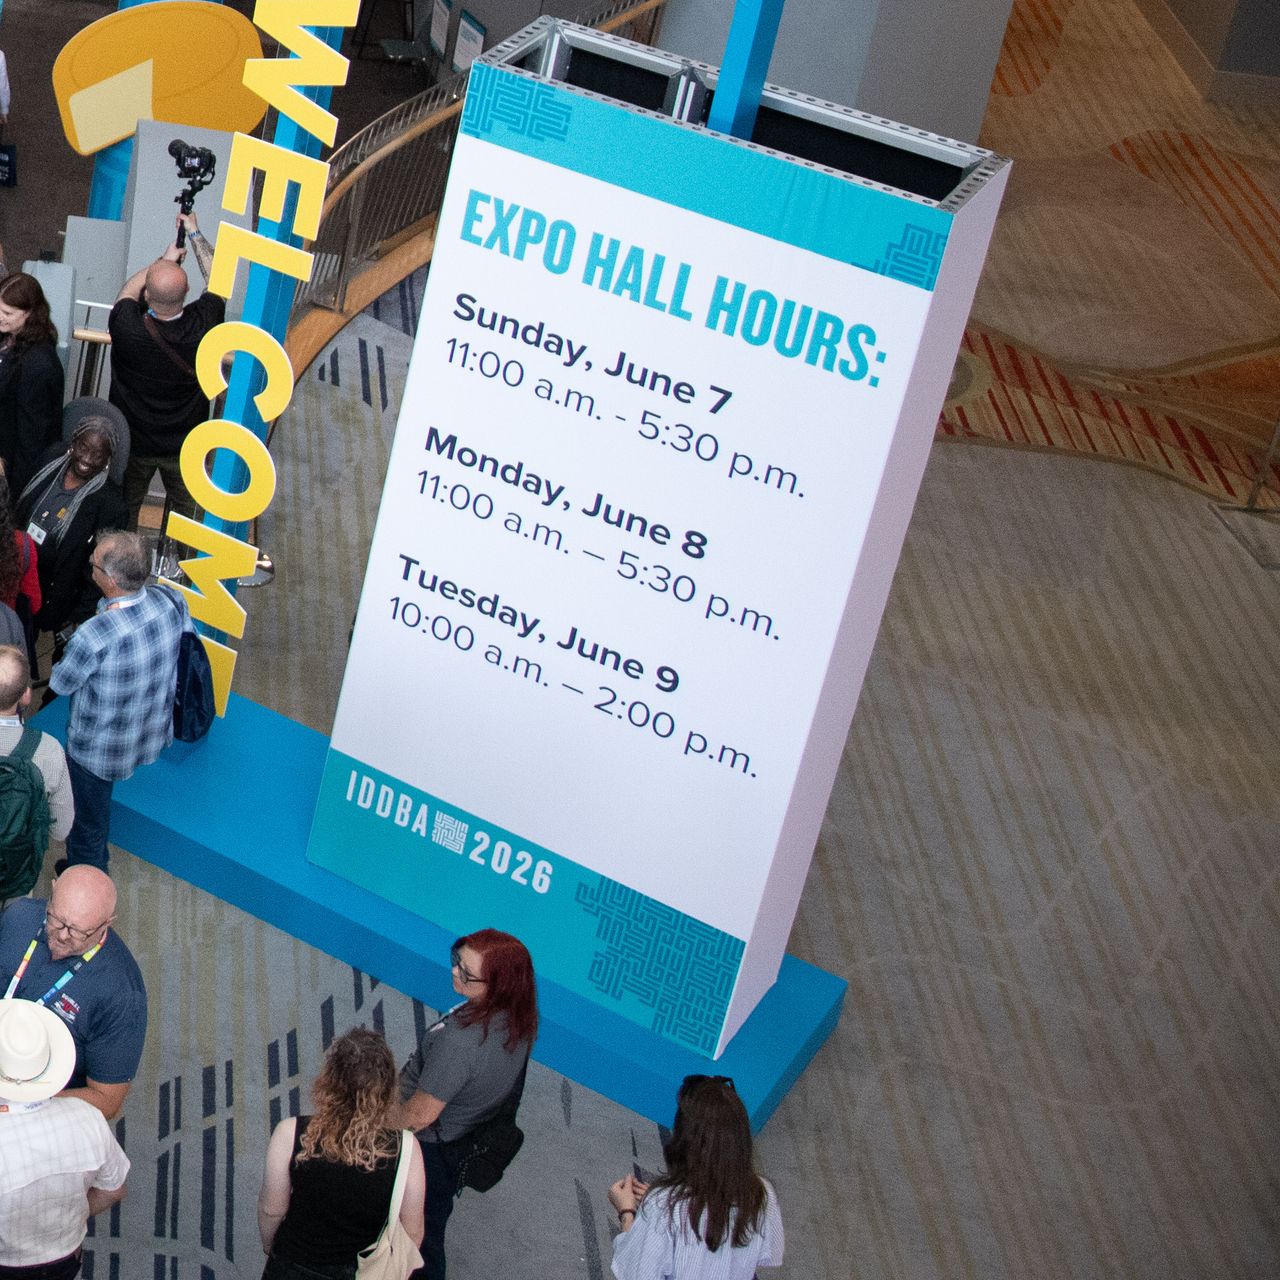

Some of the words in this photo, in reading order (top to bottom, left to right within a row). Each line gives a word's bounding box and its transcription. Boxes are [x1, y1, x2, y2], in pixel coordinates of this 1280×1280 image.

[452, 293, 594, 372] Sunday,
[603, 351, 696, 405] June
[708, 384, 733, 415] 7
[460, 189, 577, 276] EXPO
[581, 232, 693, 322] HALL
[704, 275, 887, 389] HOURS:
[424, 426, 571, 512] Monday,
[581, 492, 672, 546] June
[681, 530, 708, 560] 8
[446, 337, 525, 388] 11:00
[534, 378, 602, 420] a.m.
[637, 409, 720, 462] 5:30
[727, 451, 806, 499] p.m.
[398, 553, 546, 644] Tuesday,
[556, 626, 645, 680] June
[655, 665, 680, 694] 9
[417, 470, 494, 520] 11:00
[503, 512, 570, 555] a.m.
[616, 550, 697, 603] 5:30
[705, 593, 781, 641] p.m.
[390, 596, 475, 652] 10:00
[484, 644, 549, 688] a.m.
[593, 686, 676, 739] 2:00
[683, 730, 758, 778] p.m.
[345, 770, 429, 838] IDDBA
[468, 831, 554, 894] 2026
